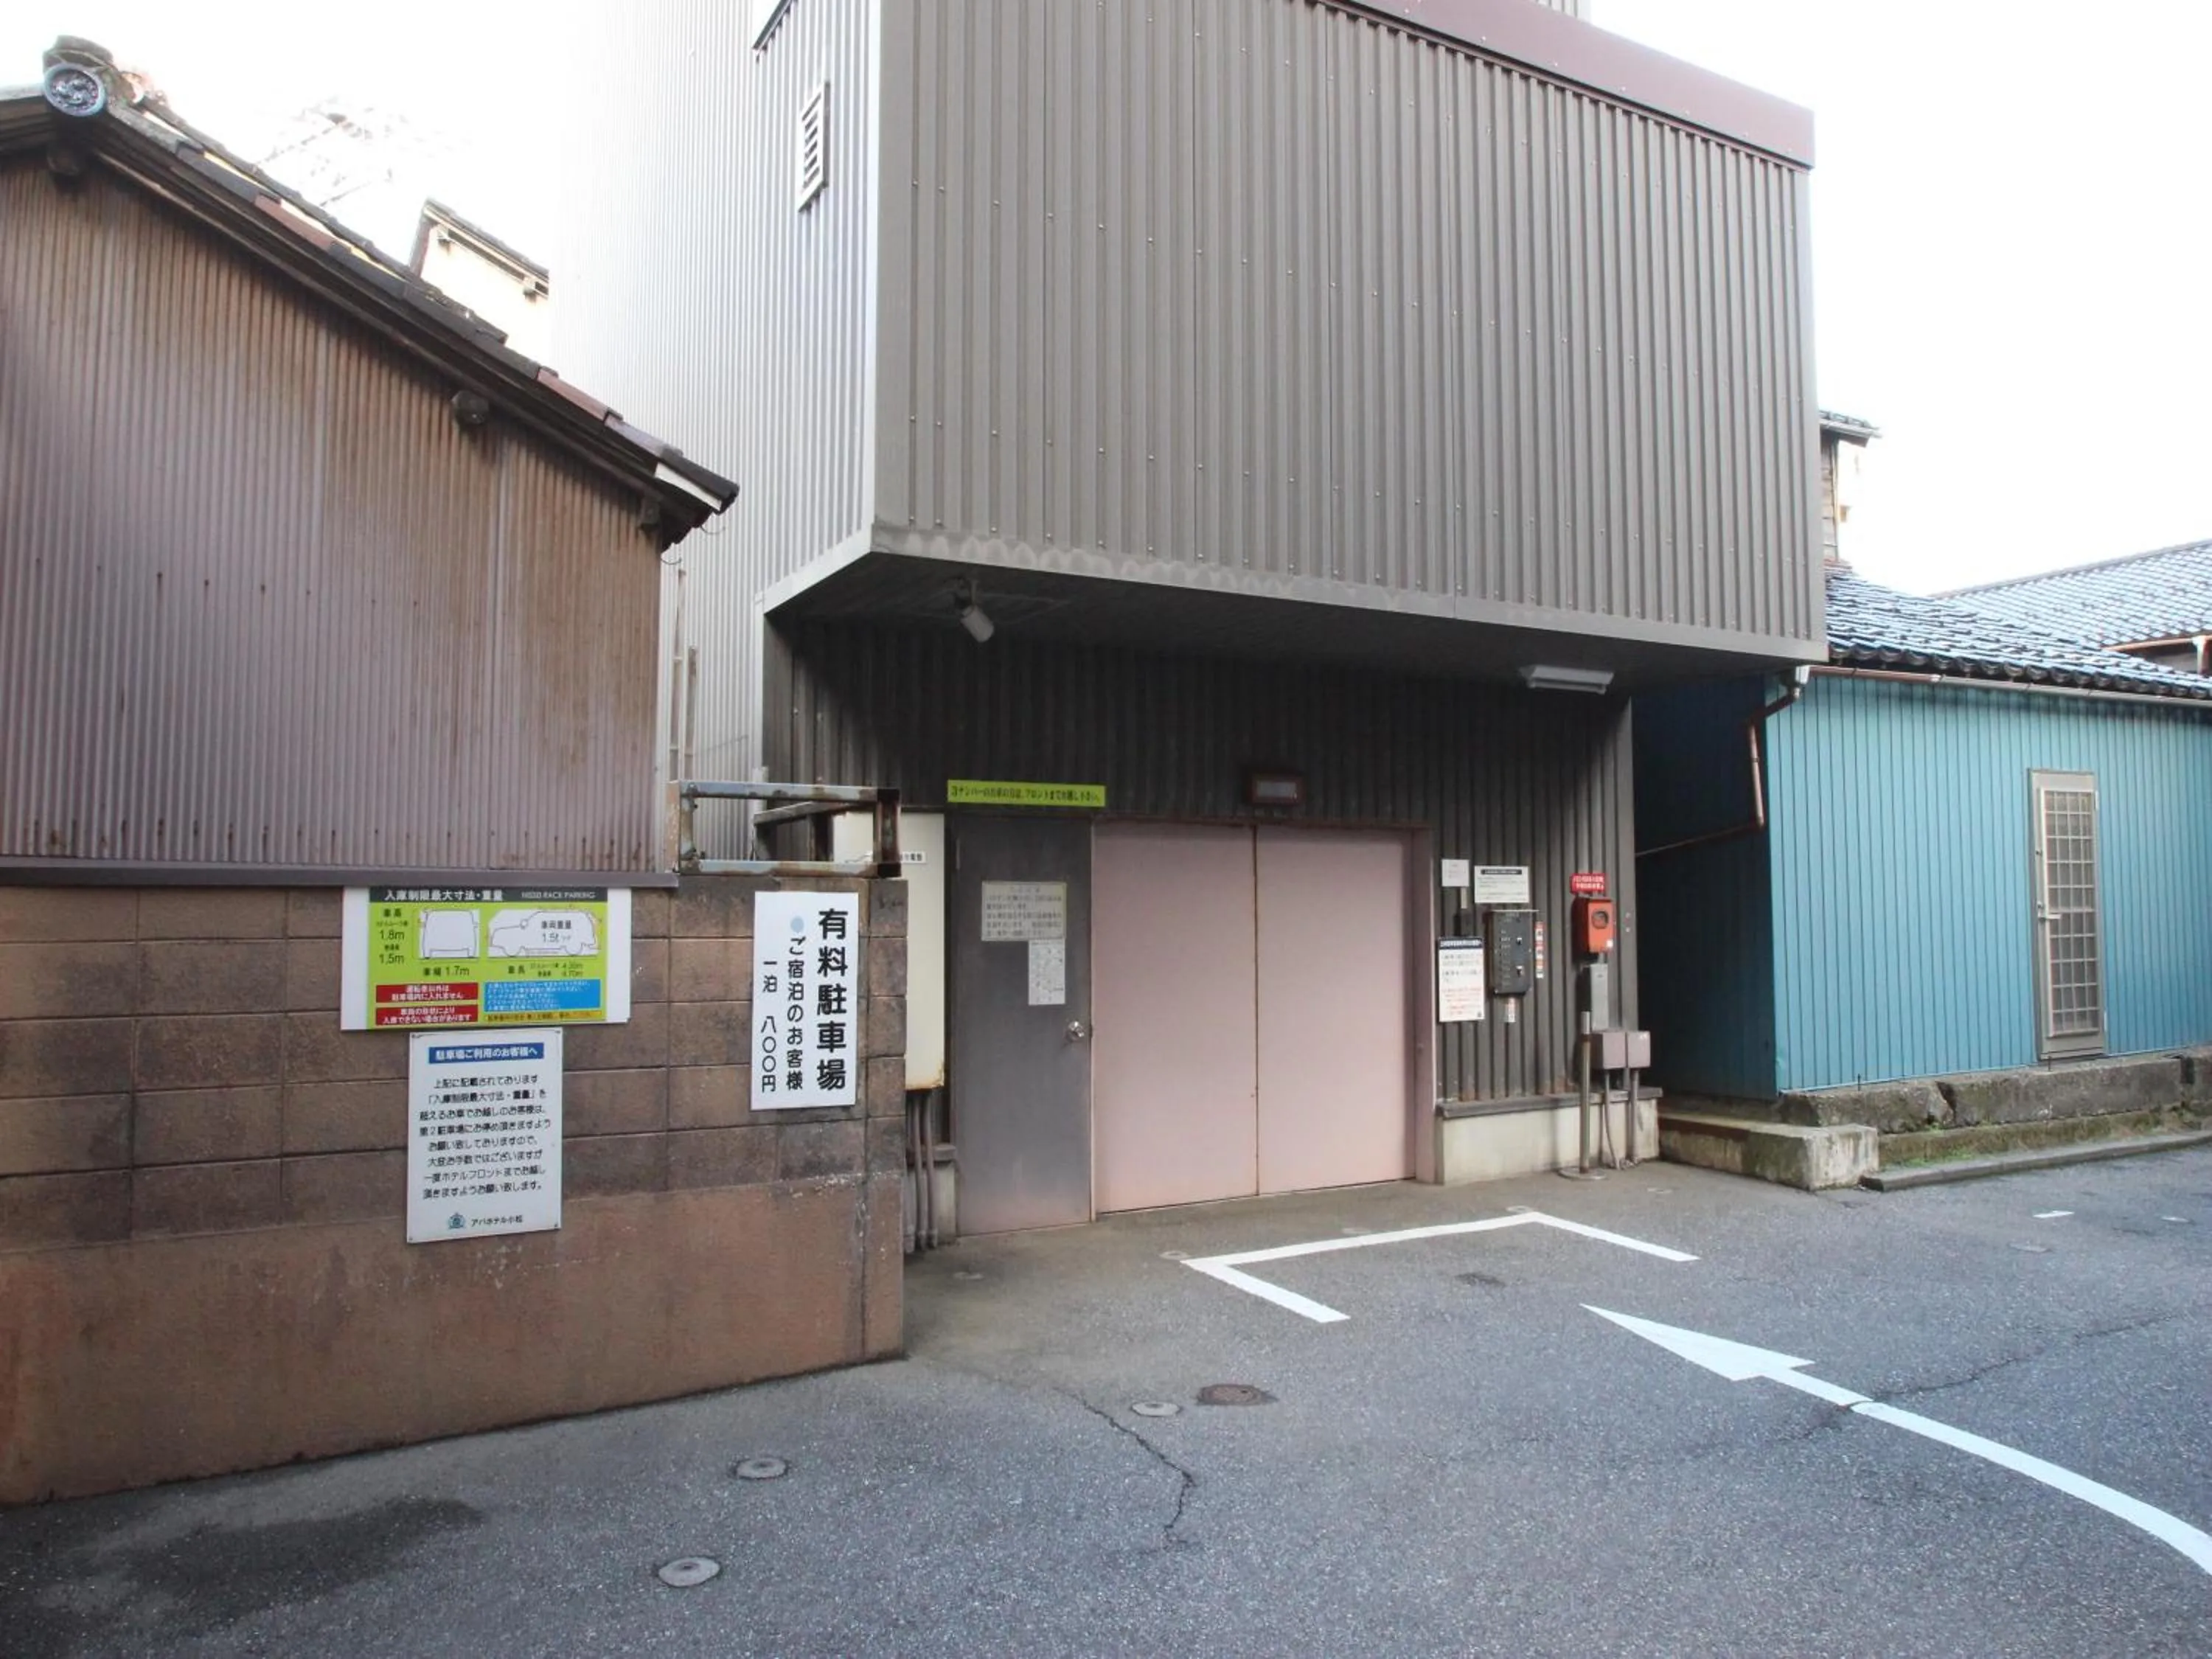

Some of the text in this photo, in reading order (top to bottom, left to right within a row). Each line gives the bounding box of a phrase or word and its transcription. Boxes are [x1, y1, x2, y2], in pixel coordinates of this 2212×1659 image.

[379, 930, 405, 940] 1.8m
[379, 953, 405, 964] 1.5m
[445, 965, 470, 977] 1.7m
[762, 960, 779, 994] 一泊
[816, 907, 849, 1092] 有料駐車場
[786, 936, 806, 1091] ご宿泊のお客様
[435, 1048, 538, 1061] 駐車場ご利用のお客様へ
[433, 1074, 538, 1089] 上記に記載されております
[427, 1150, 543, 1167] 大変お手数ではございますが
[424, 1166, 546, 1183] 一度ホテルフロントまでお越し
